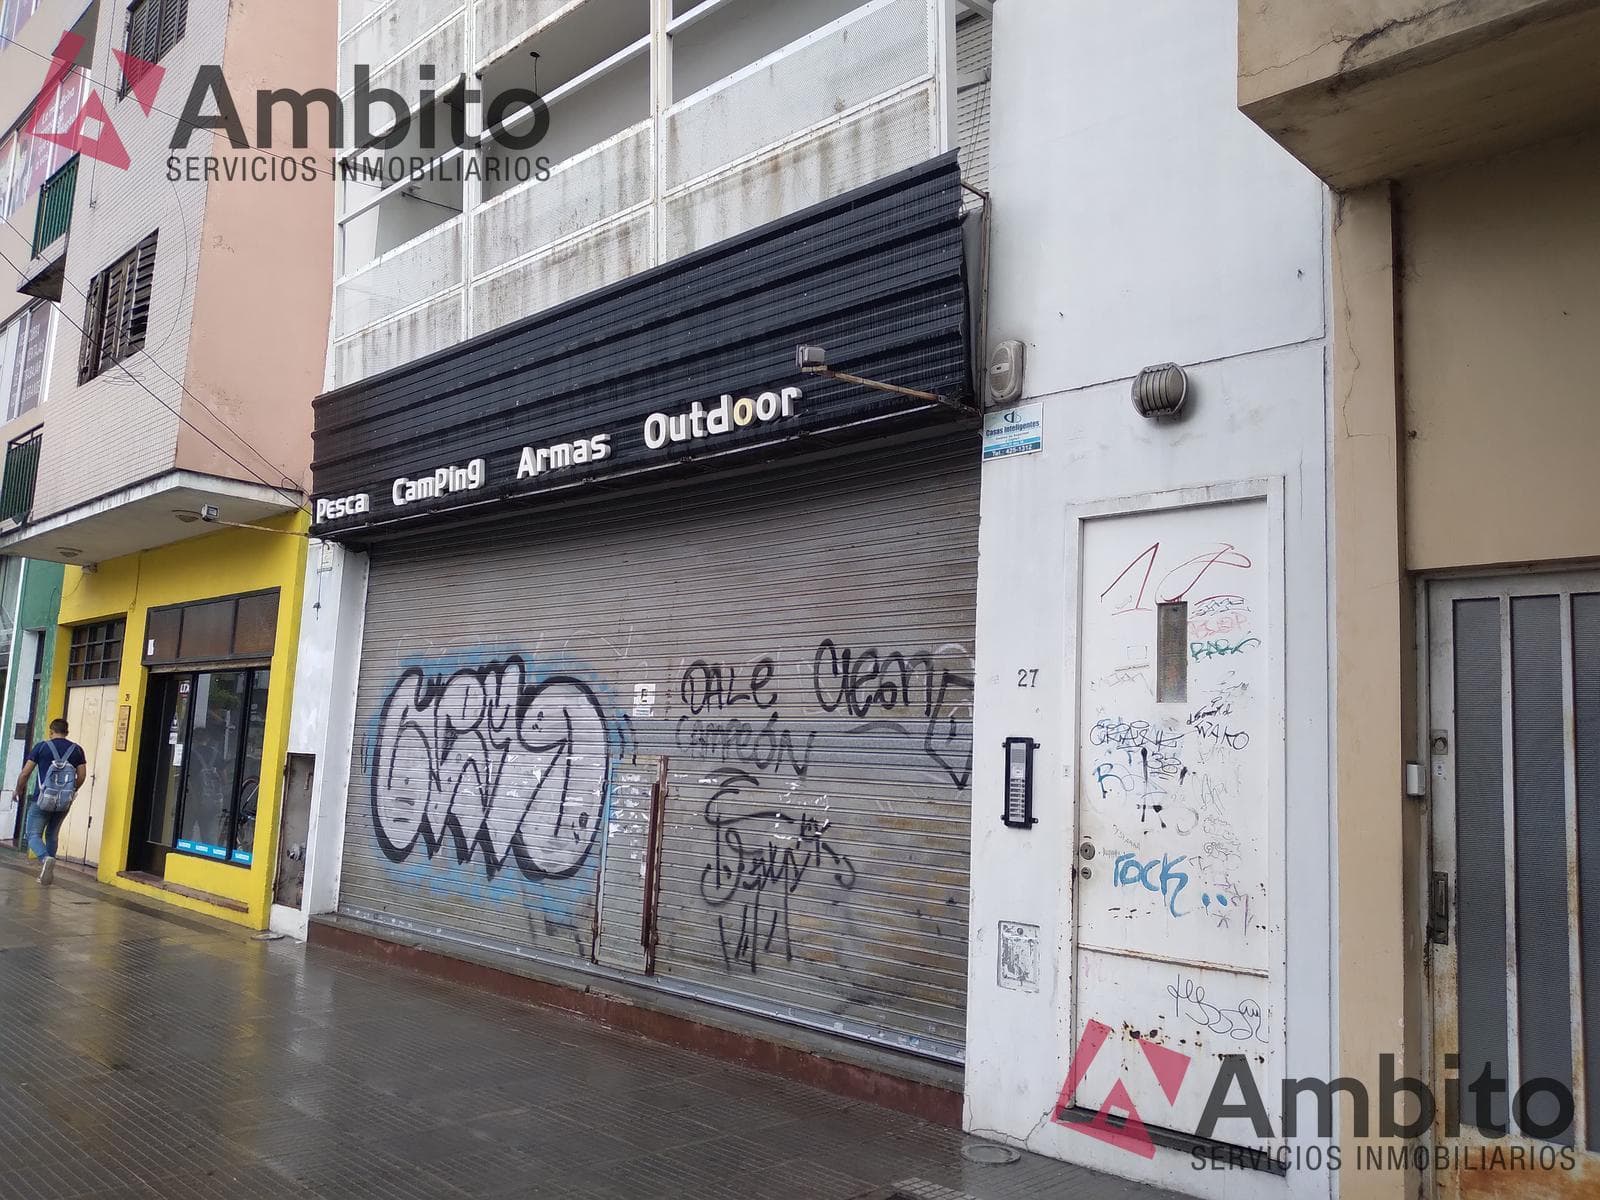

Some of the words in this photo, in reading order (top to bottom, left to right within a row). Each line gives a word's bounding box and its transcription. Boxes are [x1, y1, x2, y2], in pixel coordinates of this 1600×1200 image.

[316, 493, 370, 523] Pesca
[517, 433, 612, 479] Armas
[643, 386, 803, 450] Outdoor
[1017, 668, 1039, 688] 27
